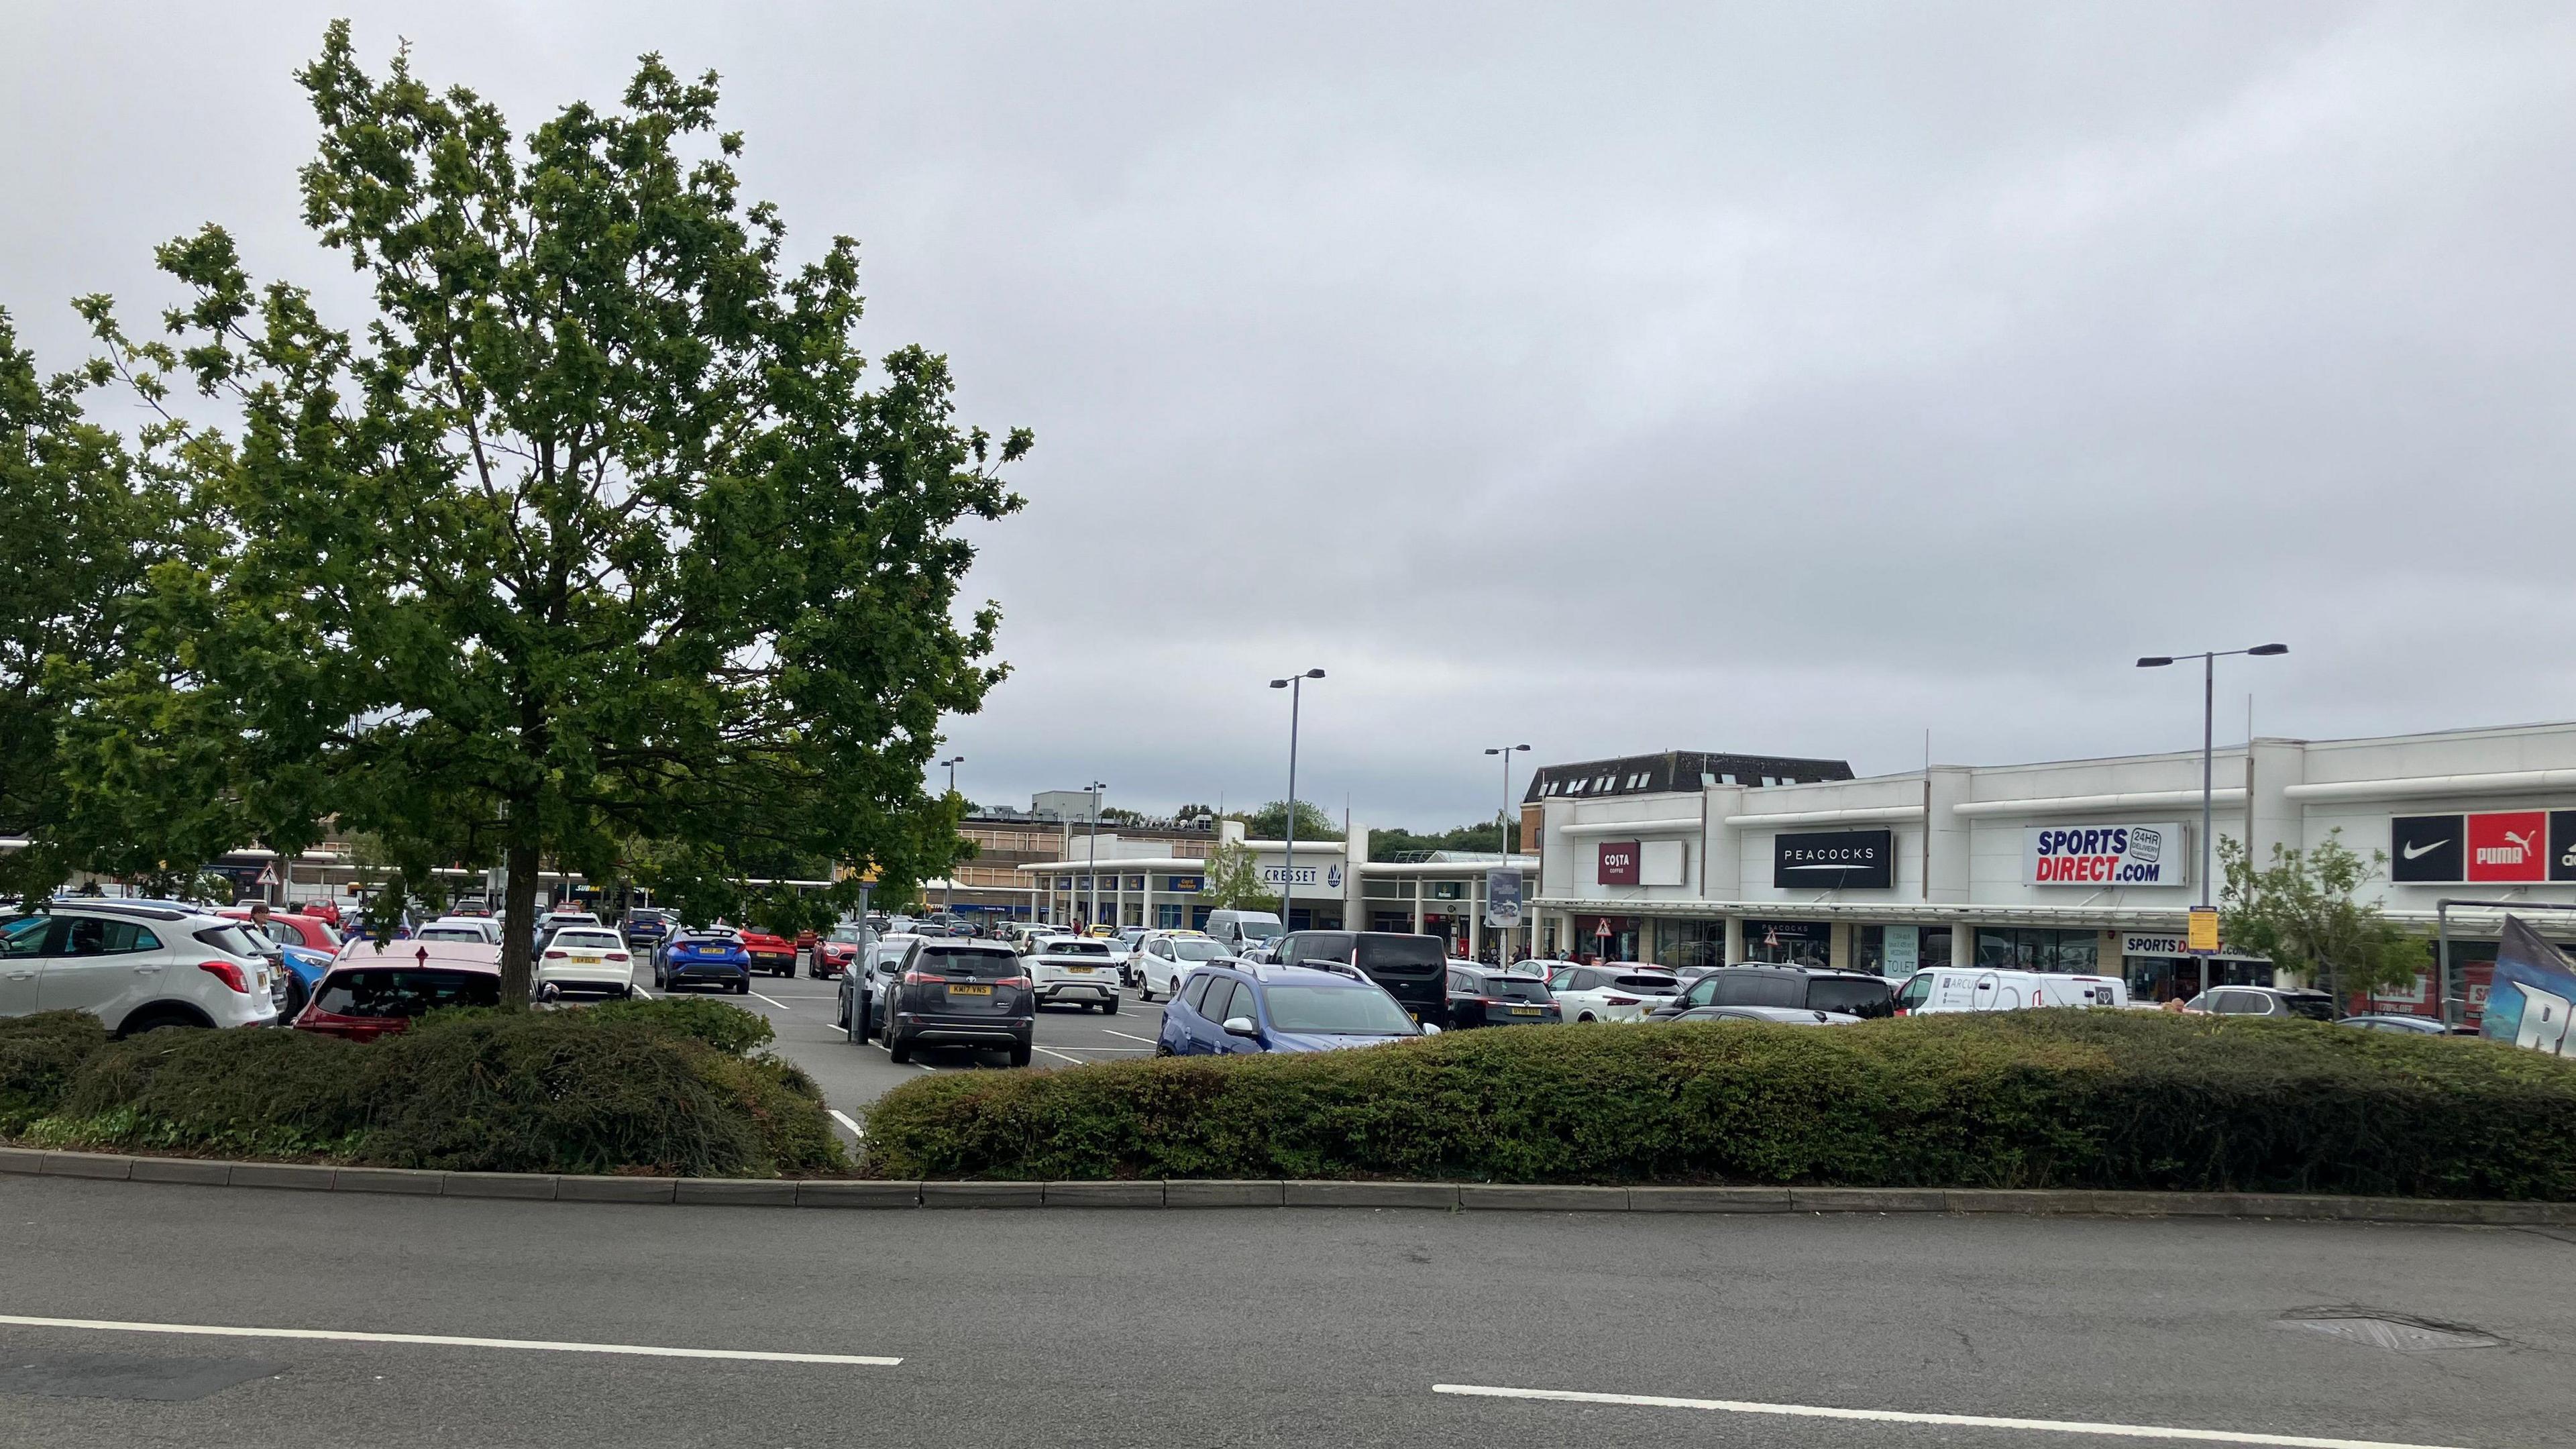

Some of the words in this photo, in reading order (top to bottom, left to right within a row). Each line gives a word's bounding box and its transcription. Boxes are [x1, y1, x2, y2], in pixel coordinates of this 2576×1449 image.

[2037, 828, 2128, 855] SPORTS
[2135, 831, 2158, 845] 24HR
[1784, 848, 1874, 860] PEACOCKS
[2132, 842, 2158, 853] DELIVERY
[1605, 854, 1629, 867] COSTA
[2477, 847, 2522, 864] PUMA
[1265, 869, 1316, 881] CRESSET
[2036, 856, 2160, 881] DIRECT.COM
[1762, 924, 1808, 932] PEACOCKS
[2128, 938, 2176, 953] SPORTS
[1888, 960, 1898, 972] TO
[1900, 961, 1915, 973] LET
